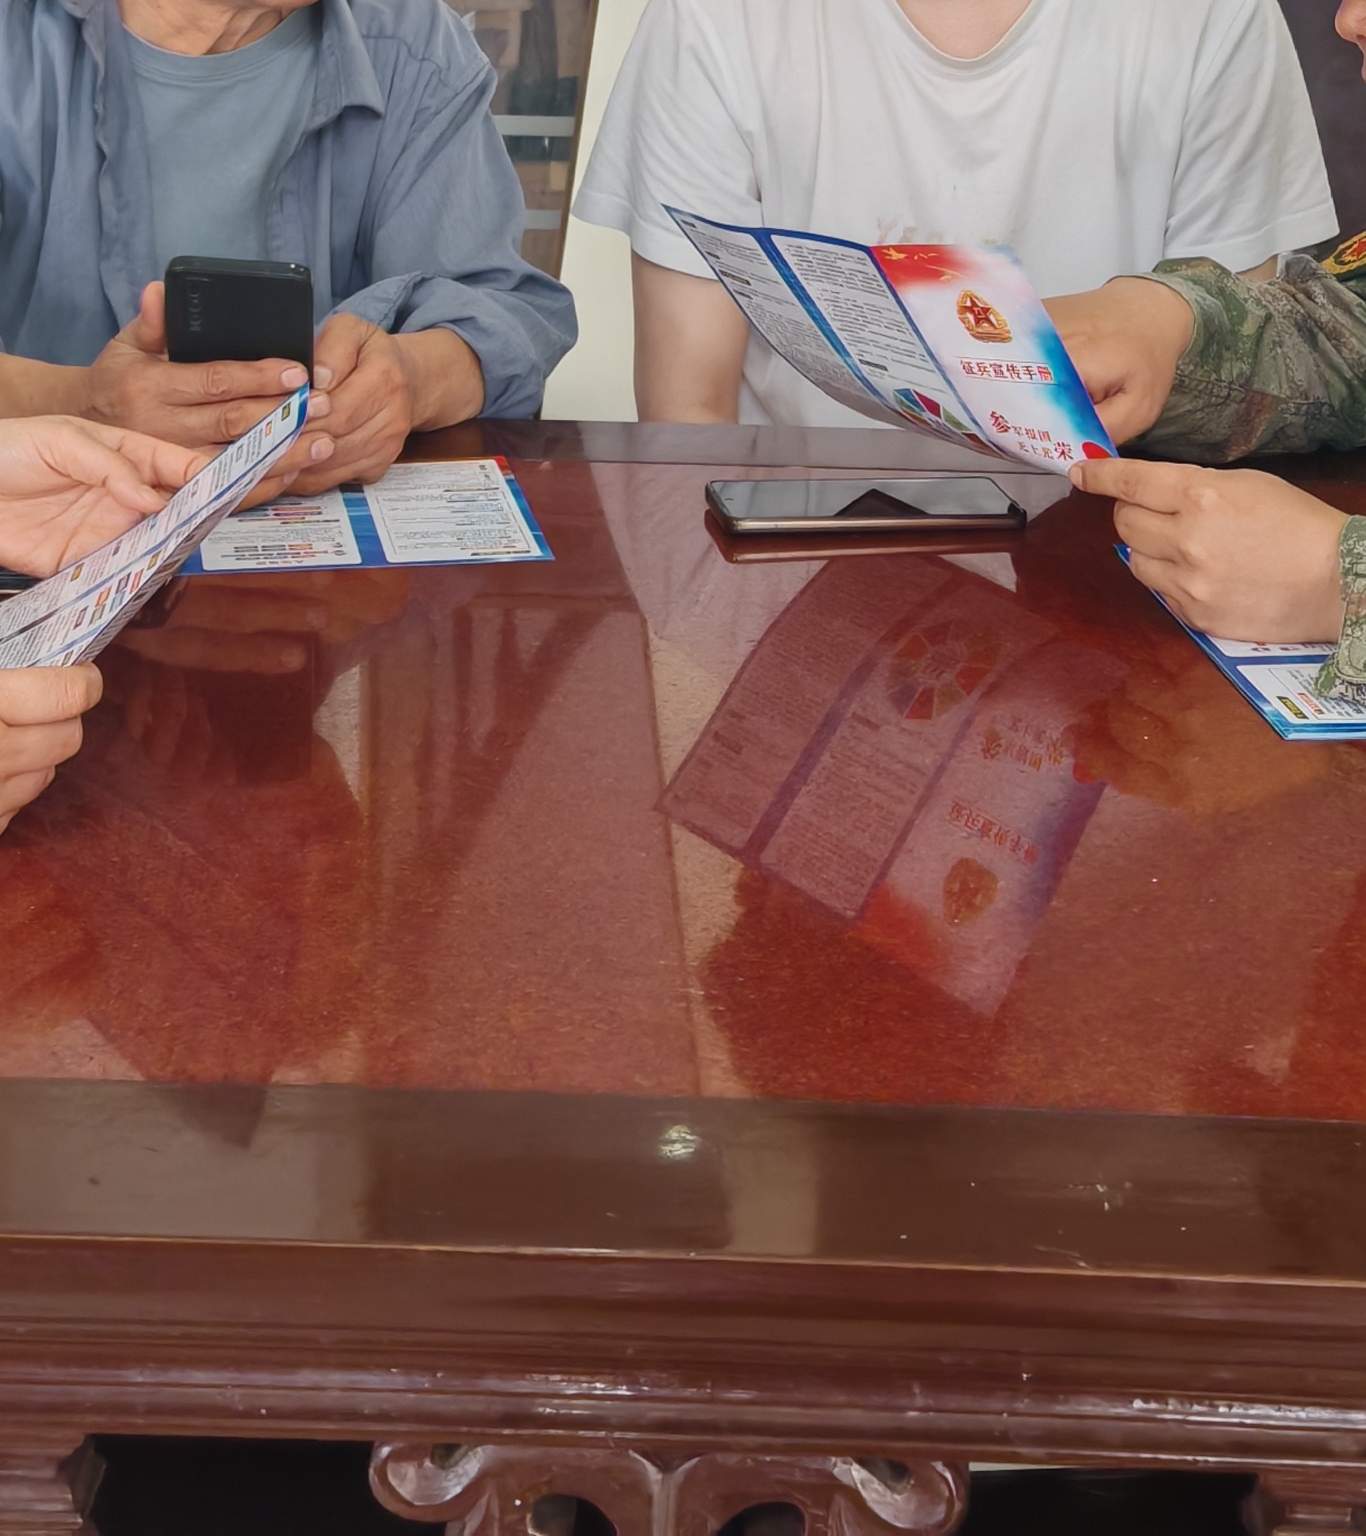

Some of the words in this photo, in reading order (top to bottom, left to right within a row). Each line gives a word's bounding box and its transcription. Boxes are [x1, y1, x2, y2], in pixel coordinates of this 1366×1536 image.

[959, 359, 1054, 382] 征兵宣传手册
